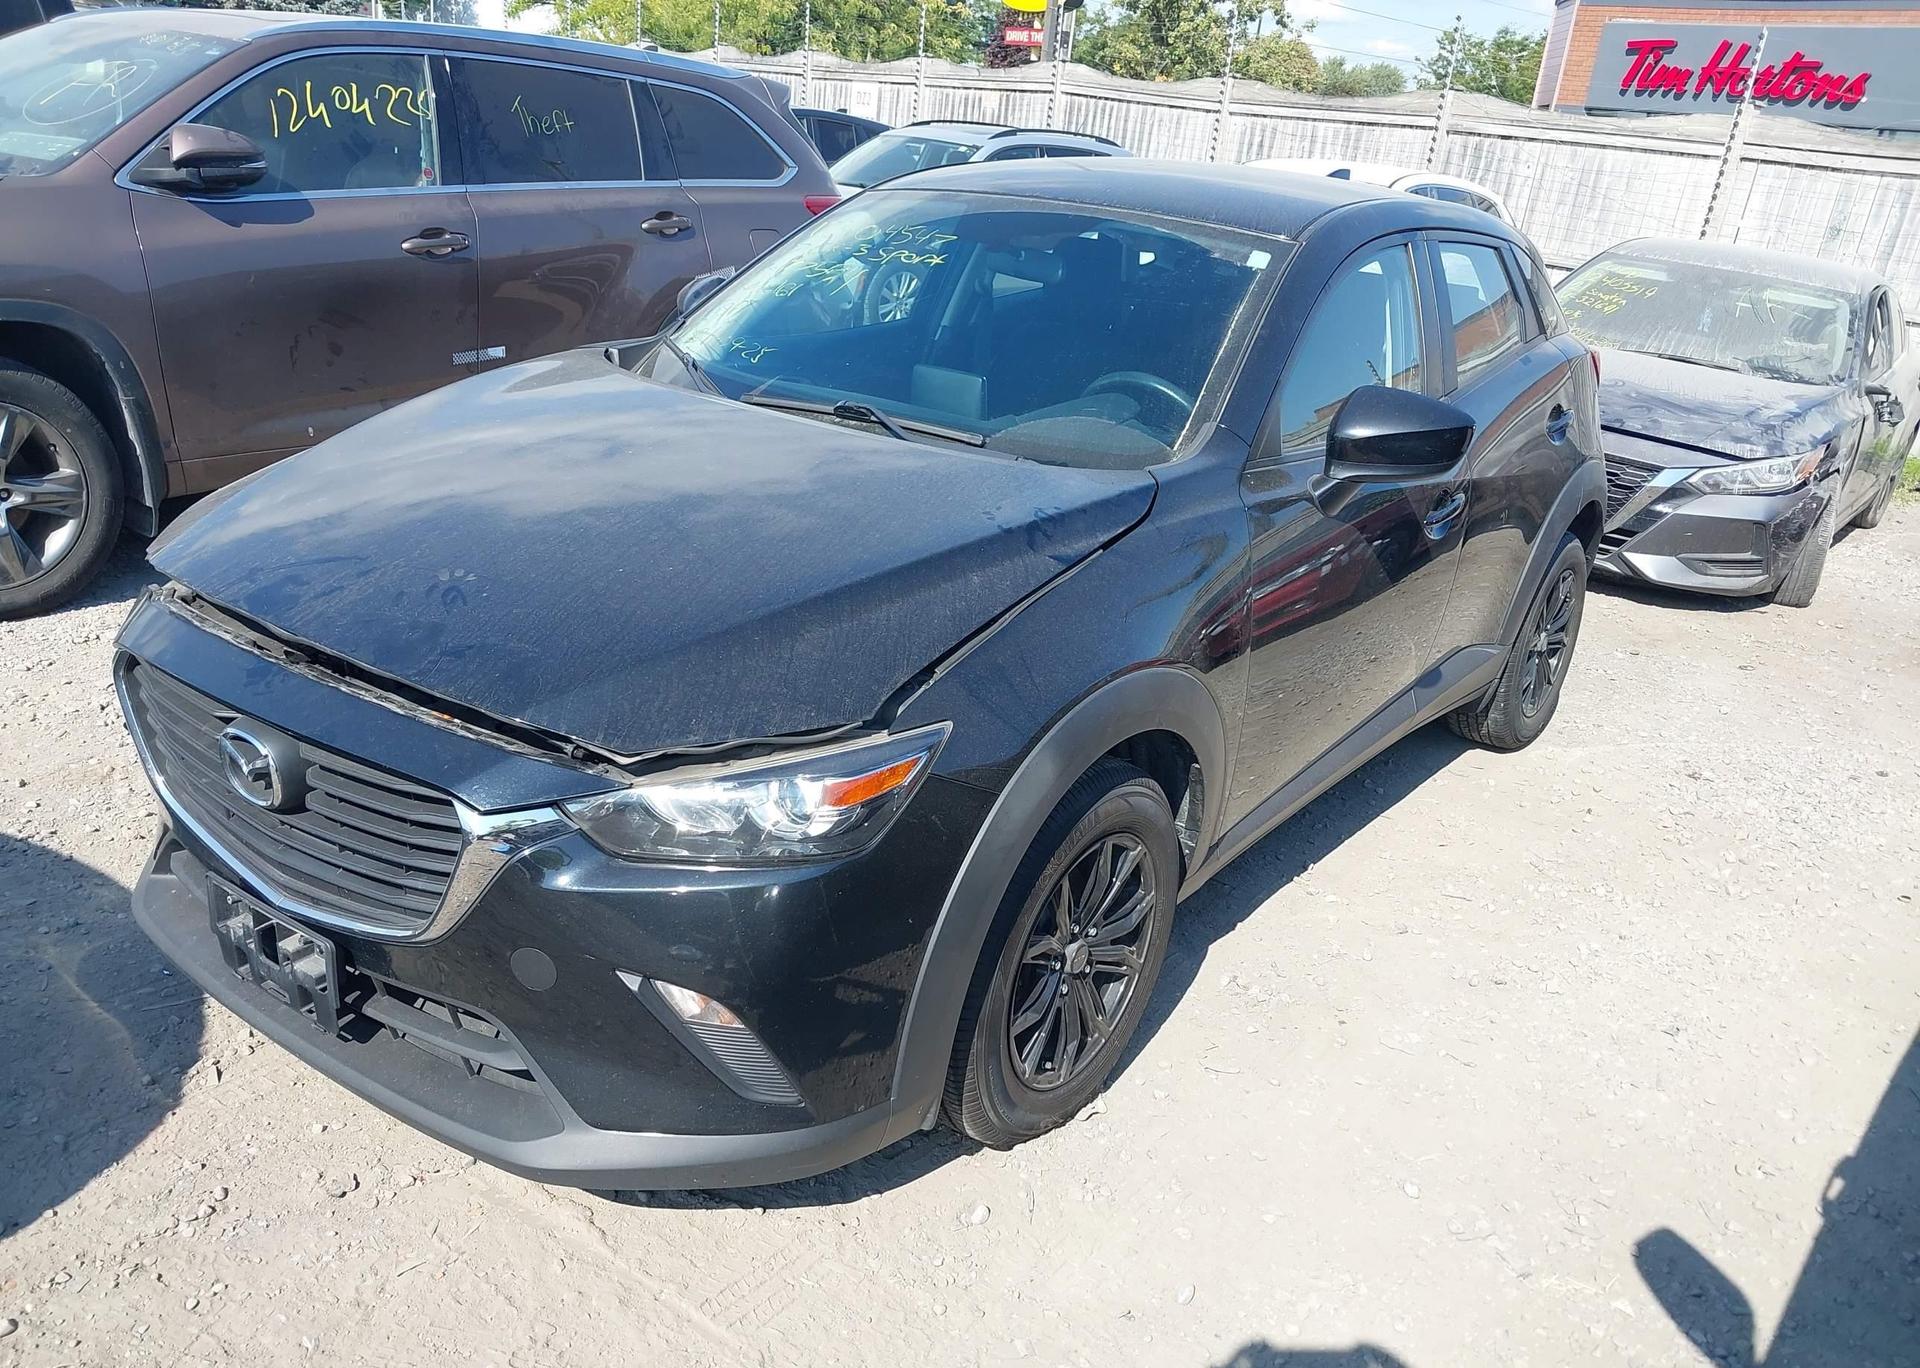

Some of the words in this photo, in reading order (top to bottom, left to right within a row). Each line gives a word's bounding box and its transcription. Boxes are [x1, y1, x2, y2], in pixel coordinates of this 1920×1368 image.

[1006, 30, 1029, 43] DRIVE
[1620, 39, 1693, 94] Tim
[1694, 39, 1872, 103] Hortons
[510, 94, 575, 138] Theft
